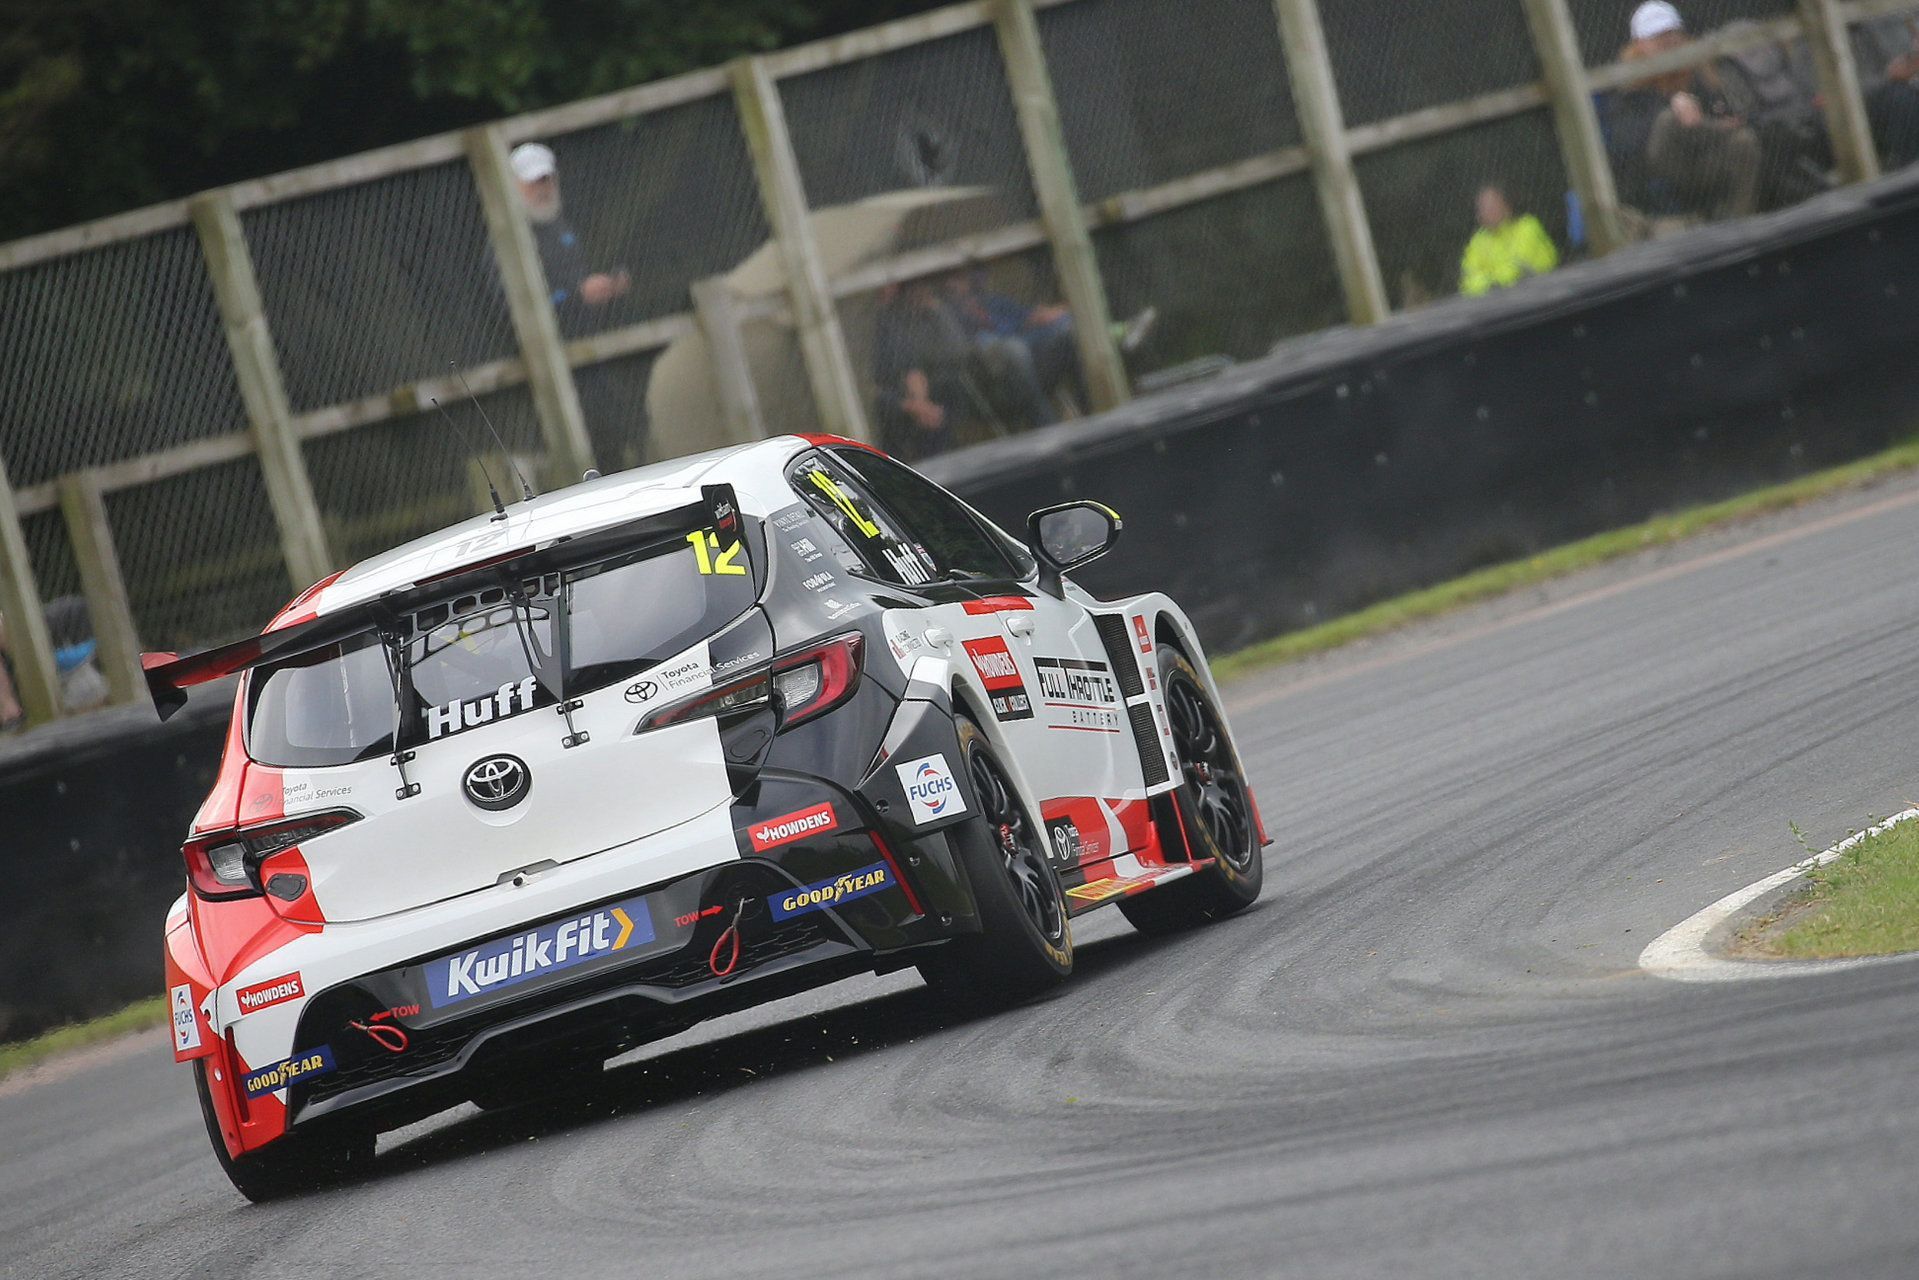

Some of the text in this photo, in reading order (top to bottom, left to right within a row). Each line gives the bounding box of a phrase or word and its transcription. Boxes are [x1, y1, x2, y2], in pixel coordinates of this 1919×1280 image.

[686, 530, 746, 575] 12
[882, 542, 931, 586] Huff
[661, 661, 699, 680] Toyota
[668, 651, 761, 689] Financial Services
[428, 676, 537, 739] Huff
[315, 785, 353, 800] Services
[909, 775, 954, 801] FUCHS
[770, 810, 832, 841] HOWDENS
[782, 868, 886, 912] GOODYEAR
[673, 911, 700, 928] TOW
[249, 980, 300, 1007] HOWDENS
[174, 1007, 194, 1027] FUCHS
[391, 1003, 421, 1020] TOW
[247, 1054, 325, 1093] GOODYEAR
